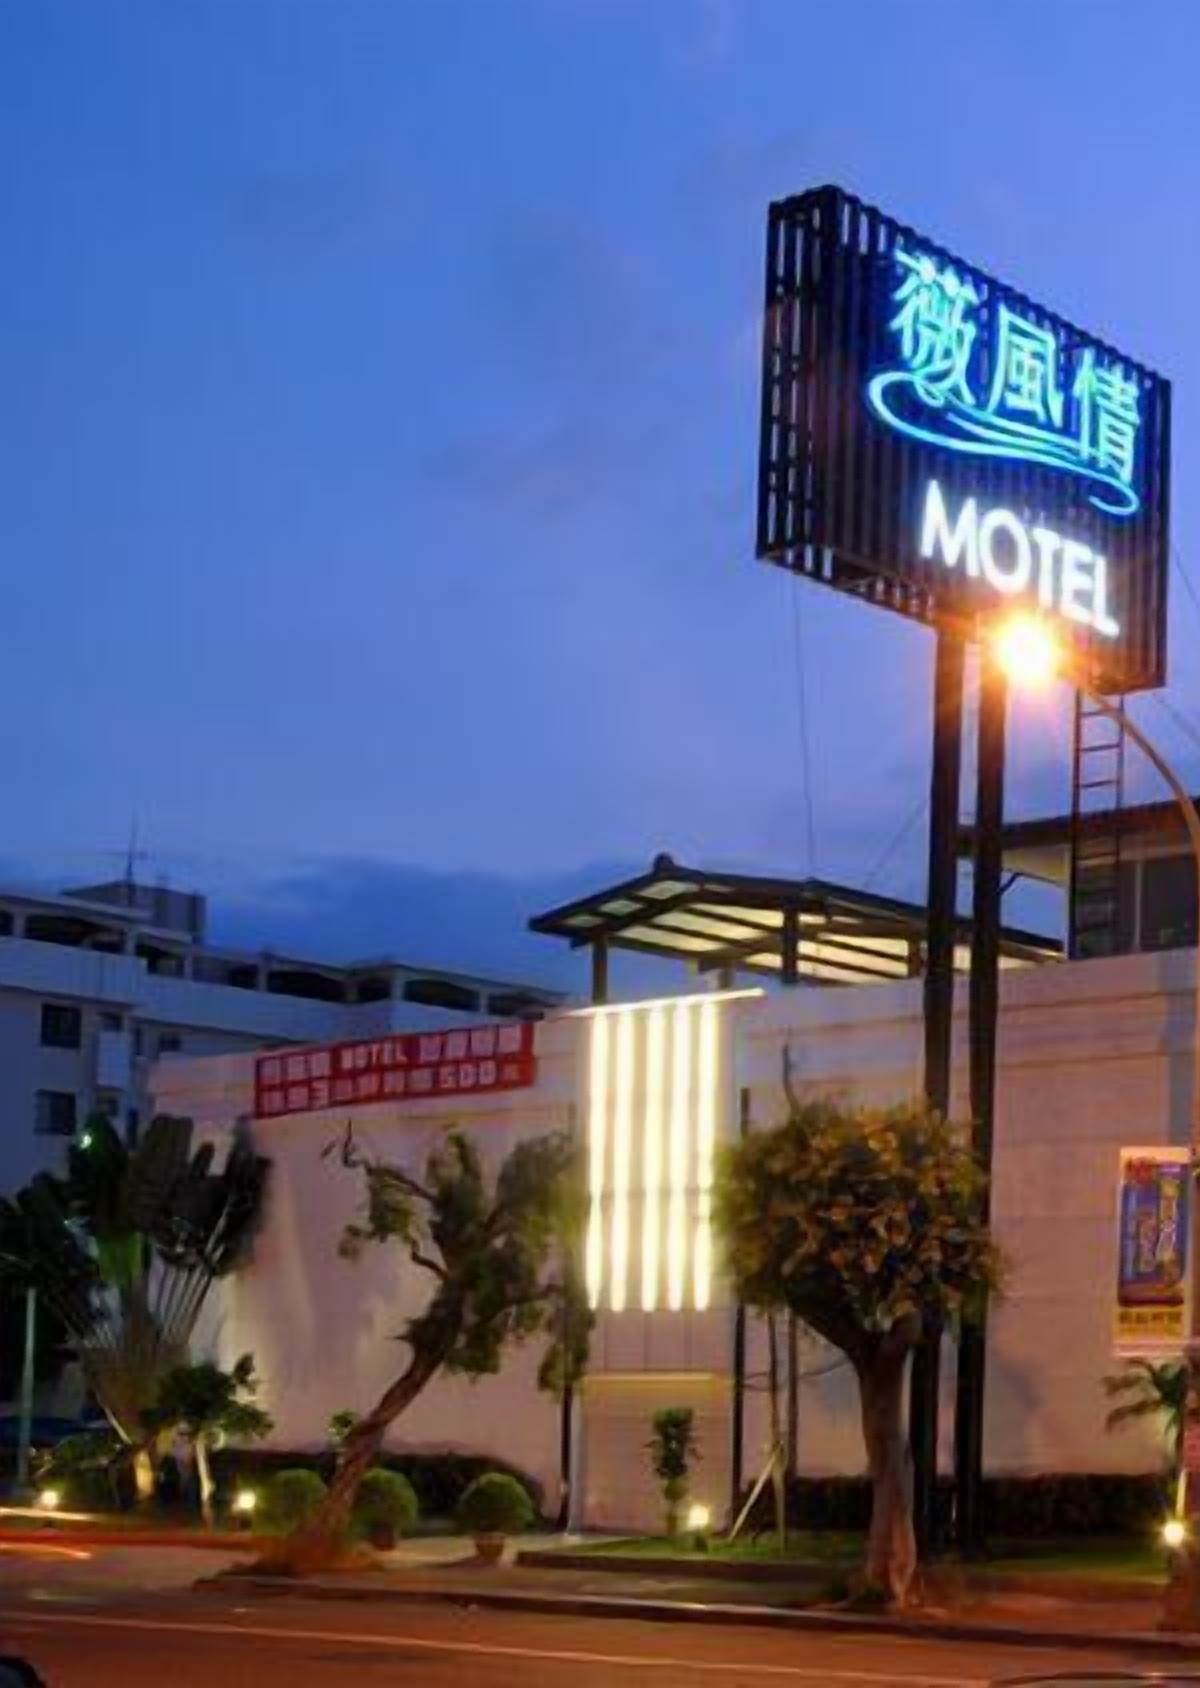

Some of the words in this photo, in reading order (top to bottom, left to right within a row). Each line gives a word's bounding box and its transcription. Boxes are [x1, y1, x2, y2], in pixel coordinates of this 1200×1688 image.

[887, 247, 1141, 484] 薇風情
[920, 479, 1120, 638] MOTEL
